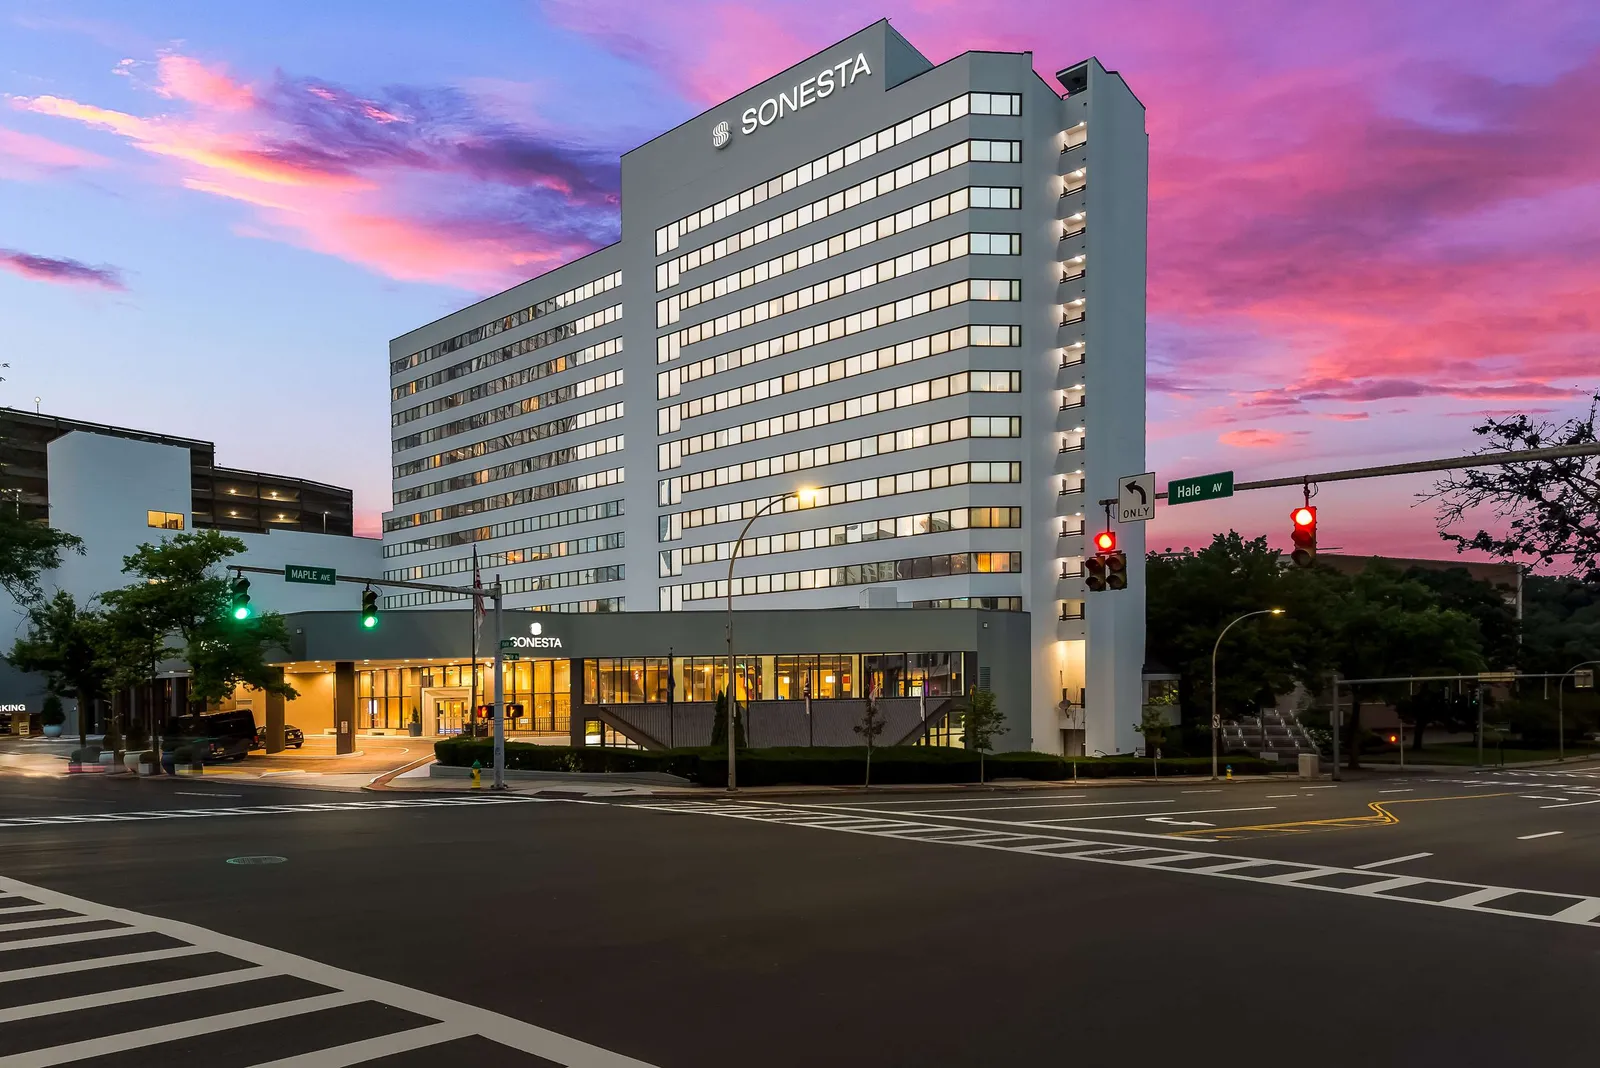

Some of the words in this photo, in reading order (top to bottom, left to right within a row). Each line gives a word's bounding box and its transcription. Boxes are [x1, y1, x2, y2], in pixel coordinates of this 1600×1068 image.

[741, 52, 872, 135] SONESTA
[1177, 484, 1201, 498] Hale
[1212, 483, 1223, 493] AV
[1123, 506, 1150, 519] ONLY
[291, 569, 317, 580] MAPLE
